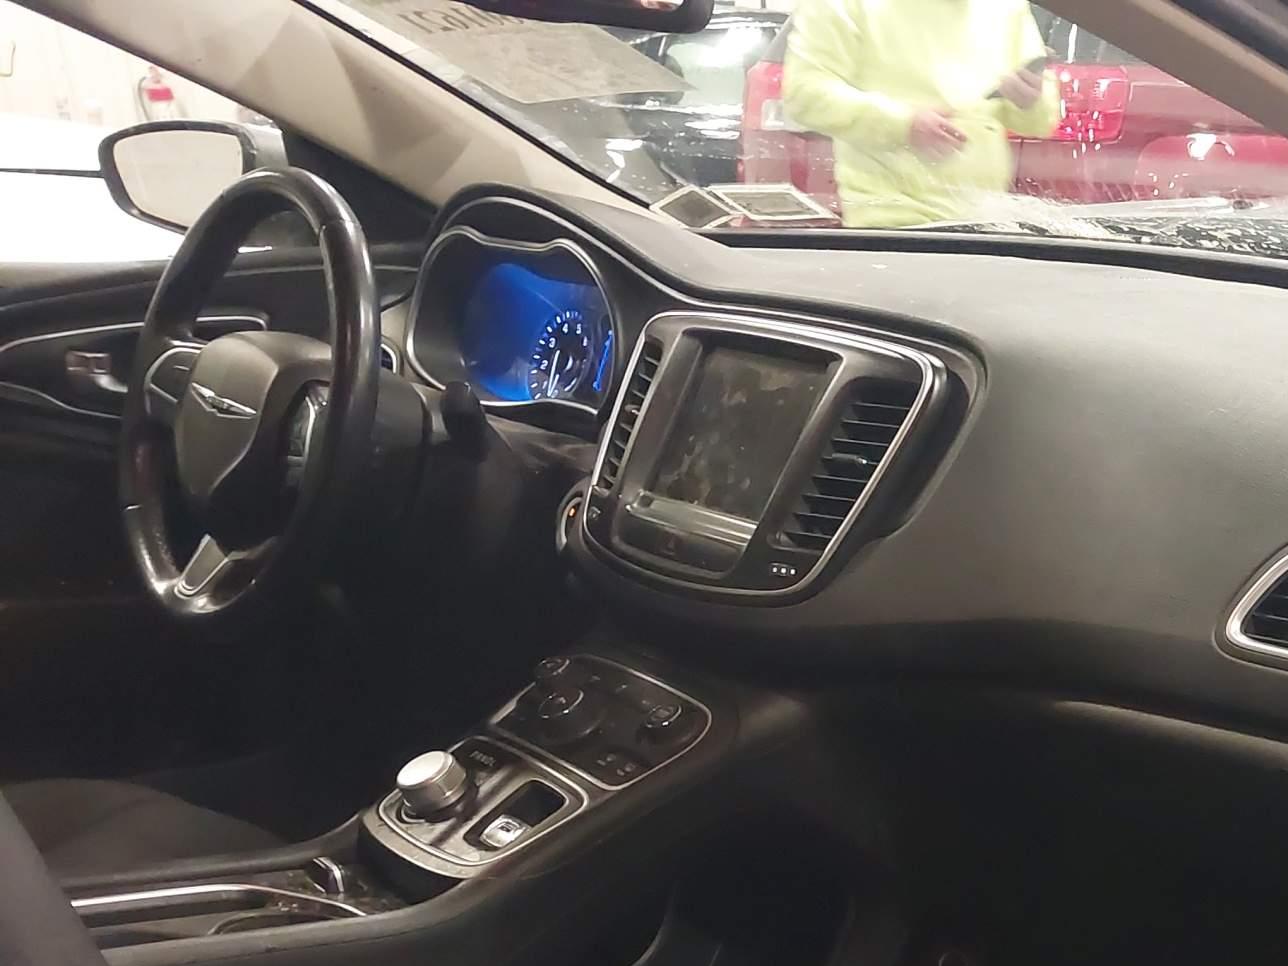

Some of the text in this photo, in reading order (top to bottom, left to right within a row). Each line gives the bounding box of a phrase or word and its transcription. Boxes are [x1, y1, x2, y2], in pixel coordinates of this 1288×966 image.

[562, 323, 568, 333] 4
[576, 323, 582, 334] 5
[548, 337, 556, 348] 3
[541, 359, 548, 370] 2
